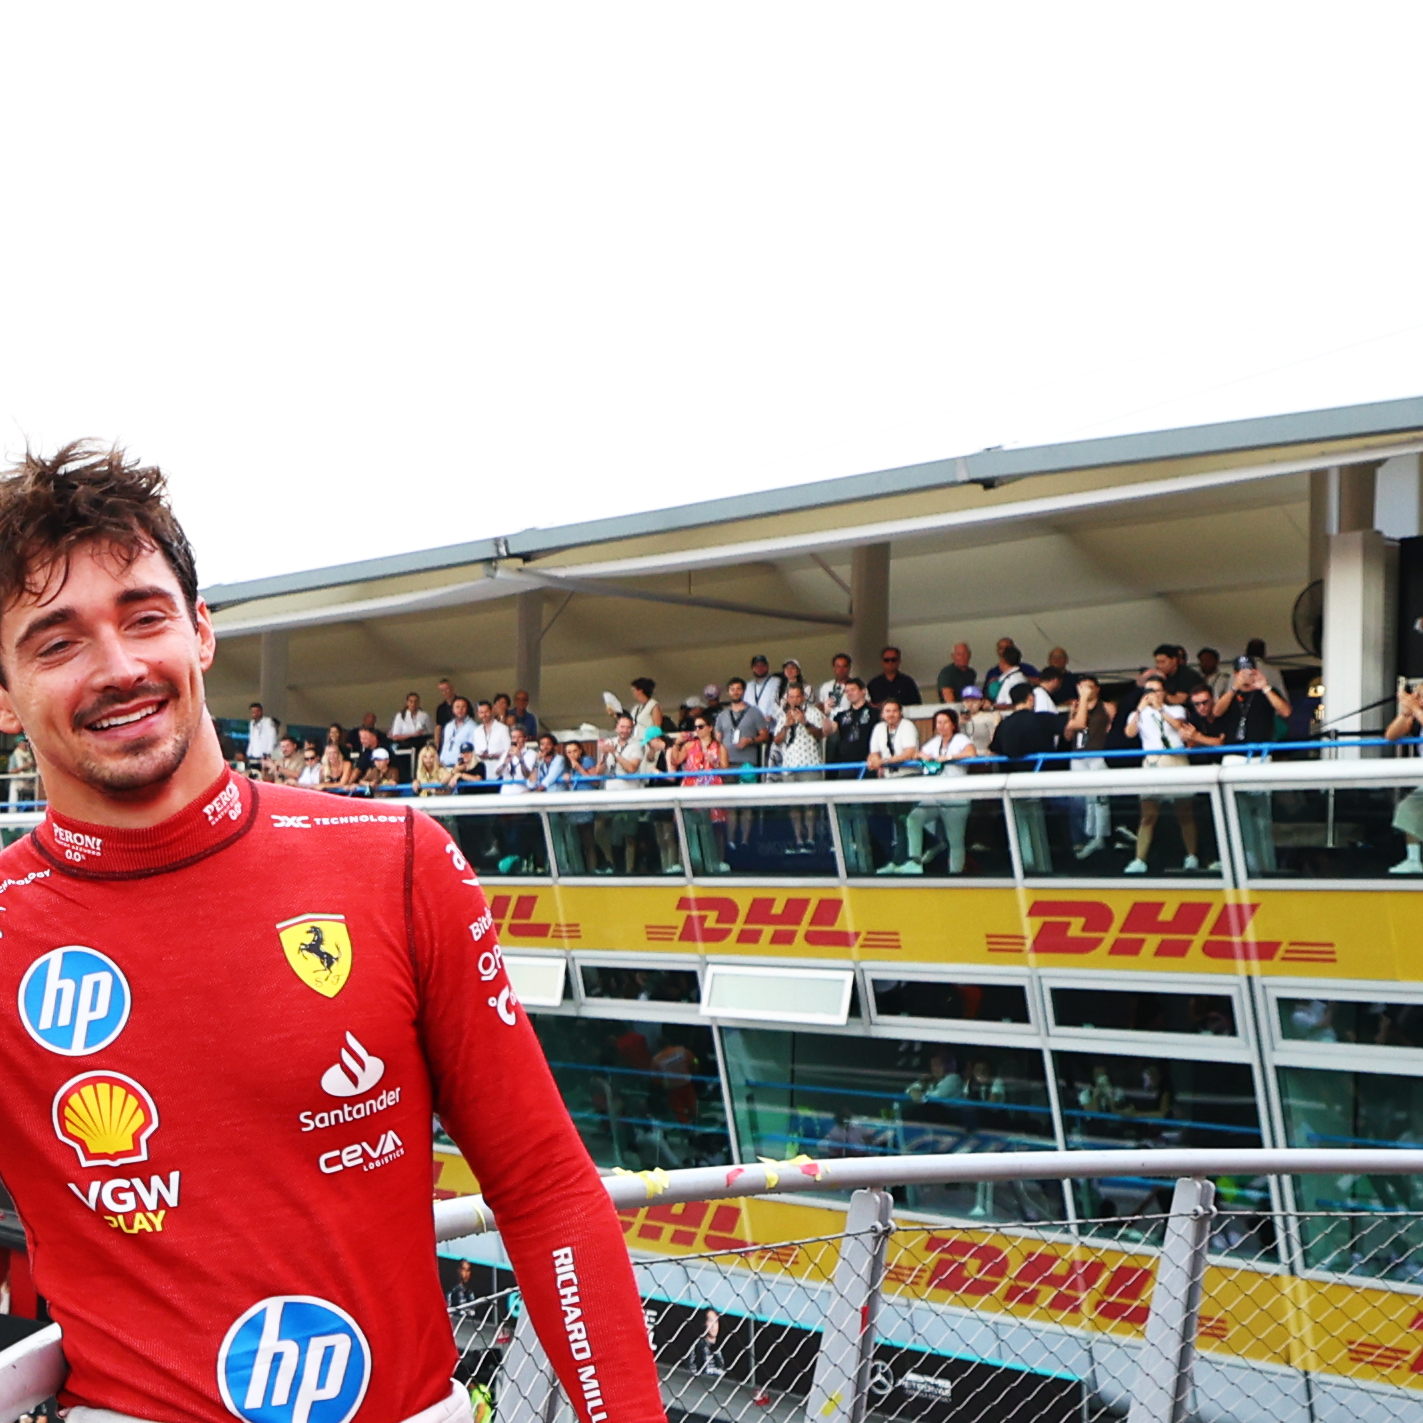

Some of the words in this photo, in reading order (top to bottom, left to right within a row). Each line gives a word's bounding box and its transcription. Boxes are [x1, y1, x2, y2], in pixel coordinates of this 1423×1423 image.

[314, 815, 406, 825] TECHNOLOGY
[674, 896, 861, 947] DHL
[1027, 900, 1284, 963] DHL
[38, 947, 114, 1056] hp
[299, 1086, 401, 1132] Santander
[363, 1148, 405, 1172] LOGISTICS
[67, 1170, 180, 1213] VGW
[552, 1246, 593, 1361] RICHARD
[924, 1236, 1153, 1325] DHL
